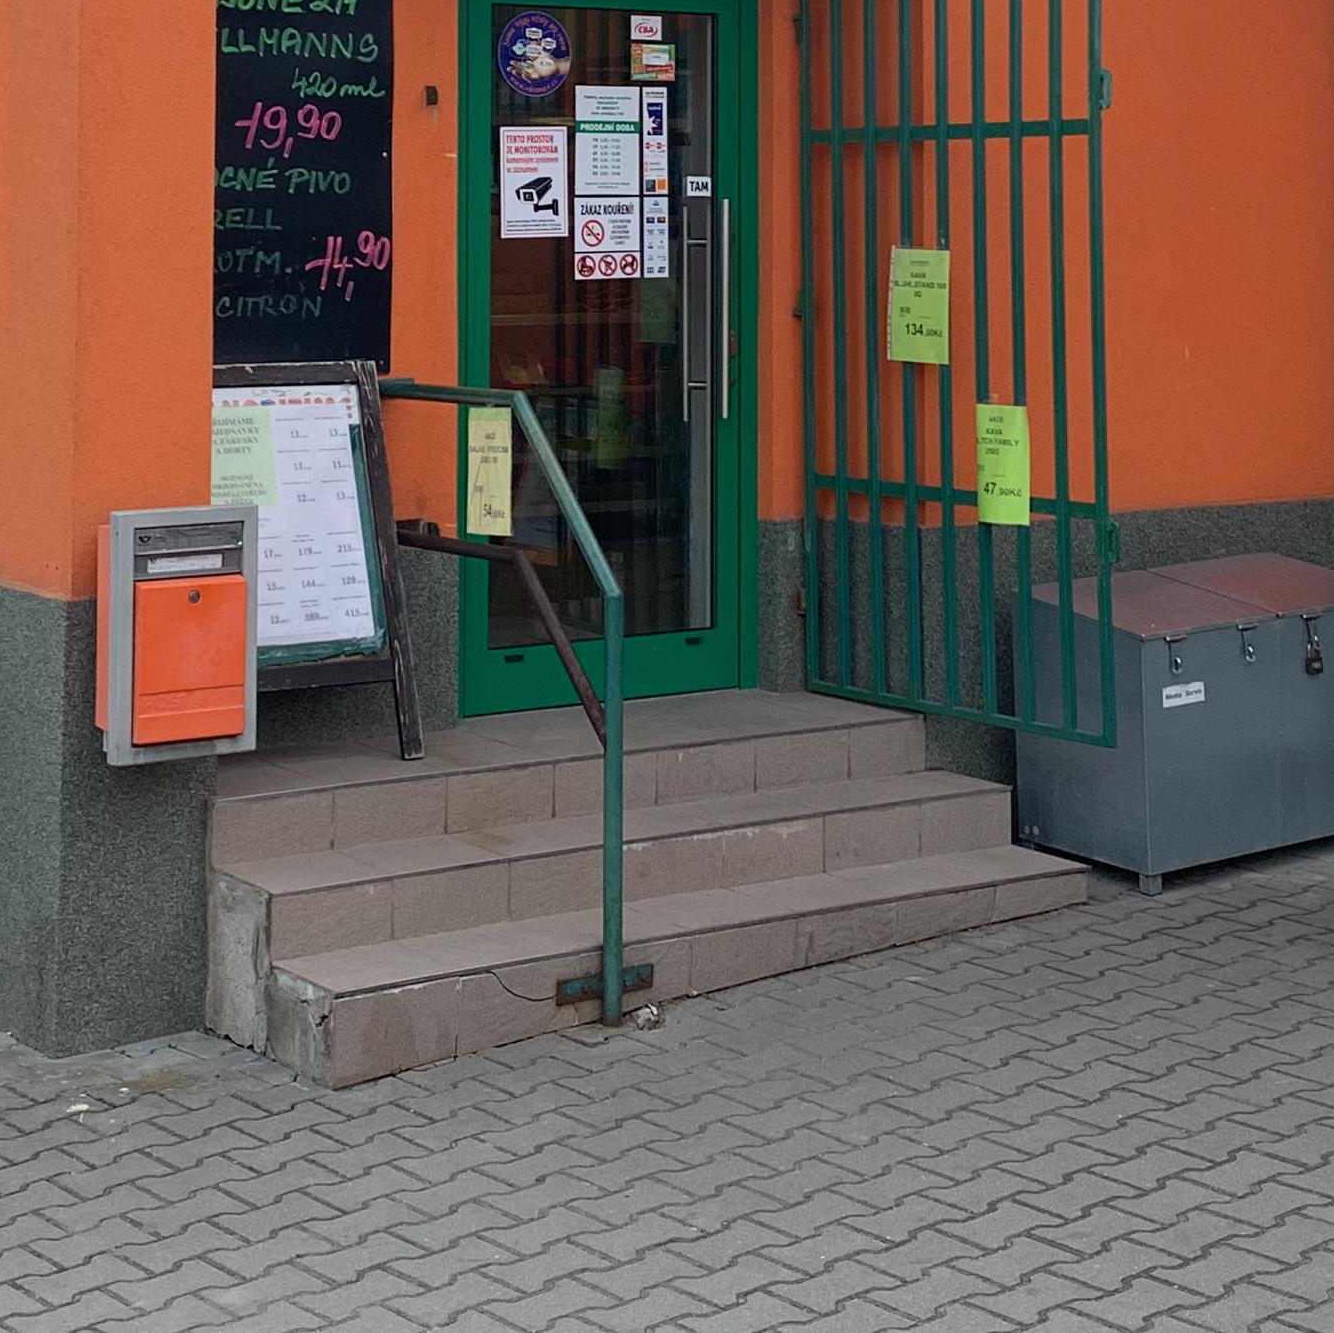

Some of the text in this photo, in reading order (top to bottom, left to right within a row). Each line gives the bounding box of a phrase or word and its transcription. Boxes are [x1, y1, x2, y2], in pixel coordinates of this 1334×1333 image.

[284, 167, 351, 194] PIVO
[689, 180, 709, 192] TAM
[580, 201, 602, 216] ZÁKAZ
